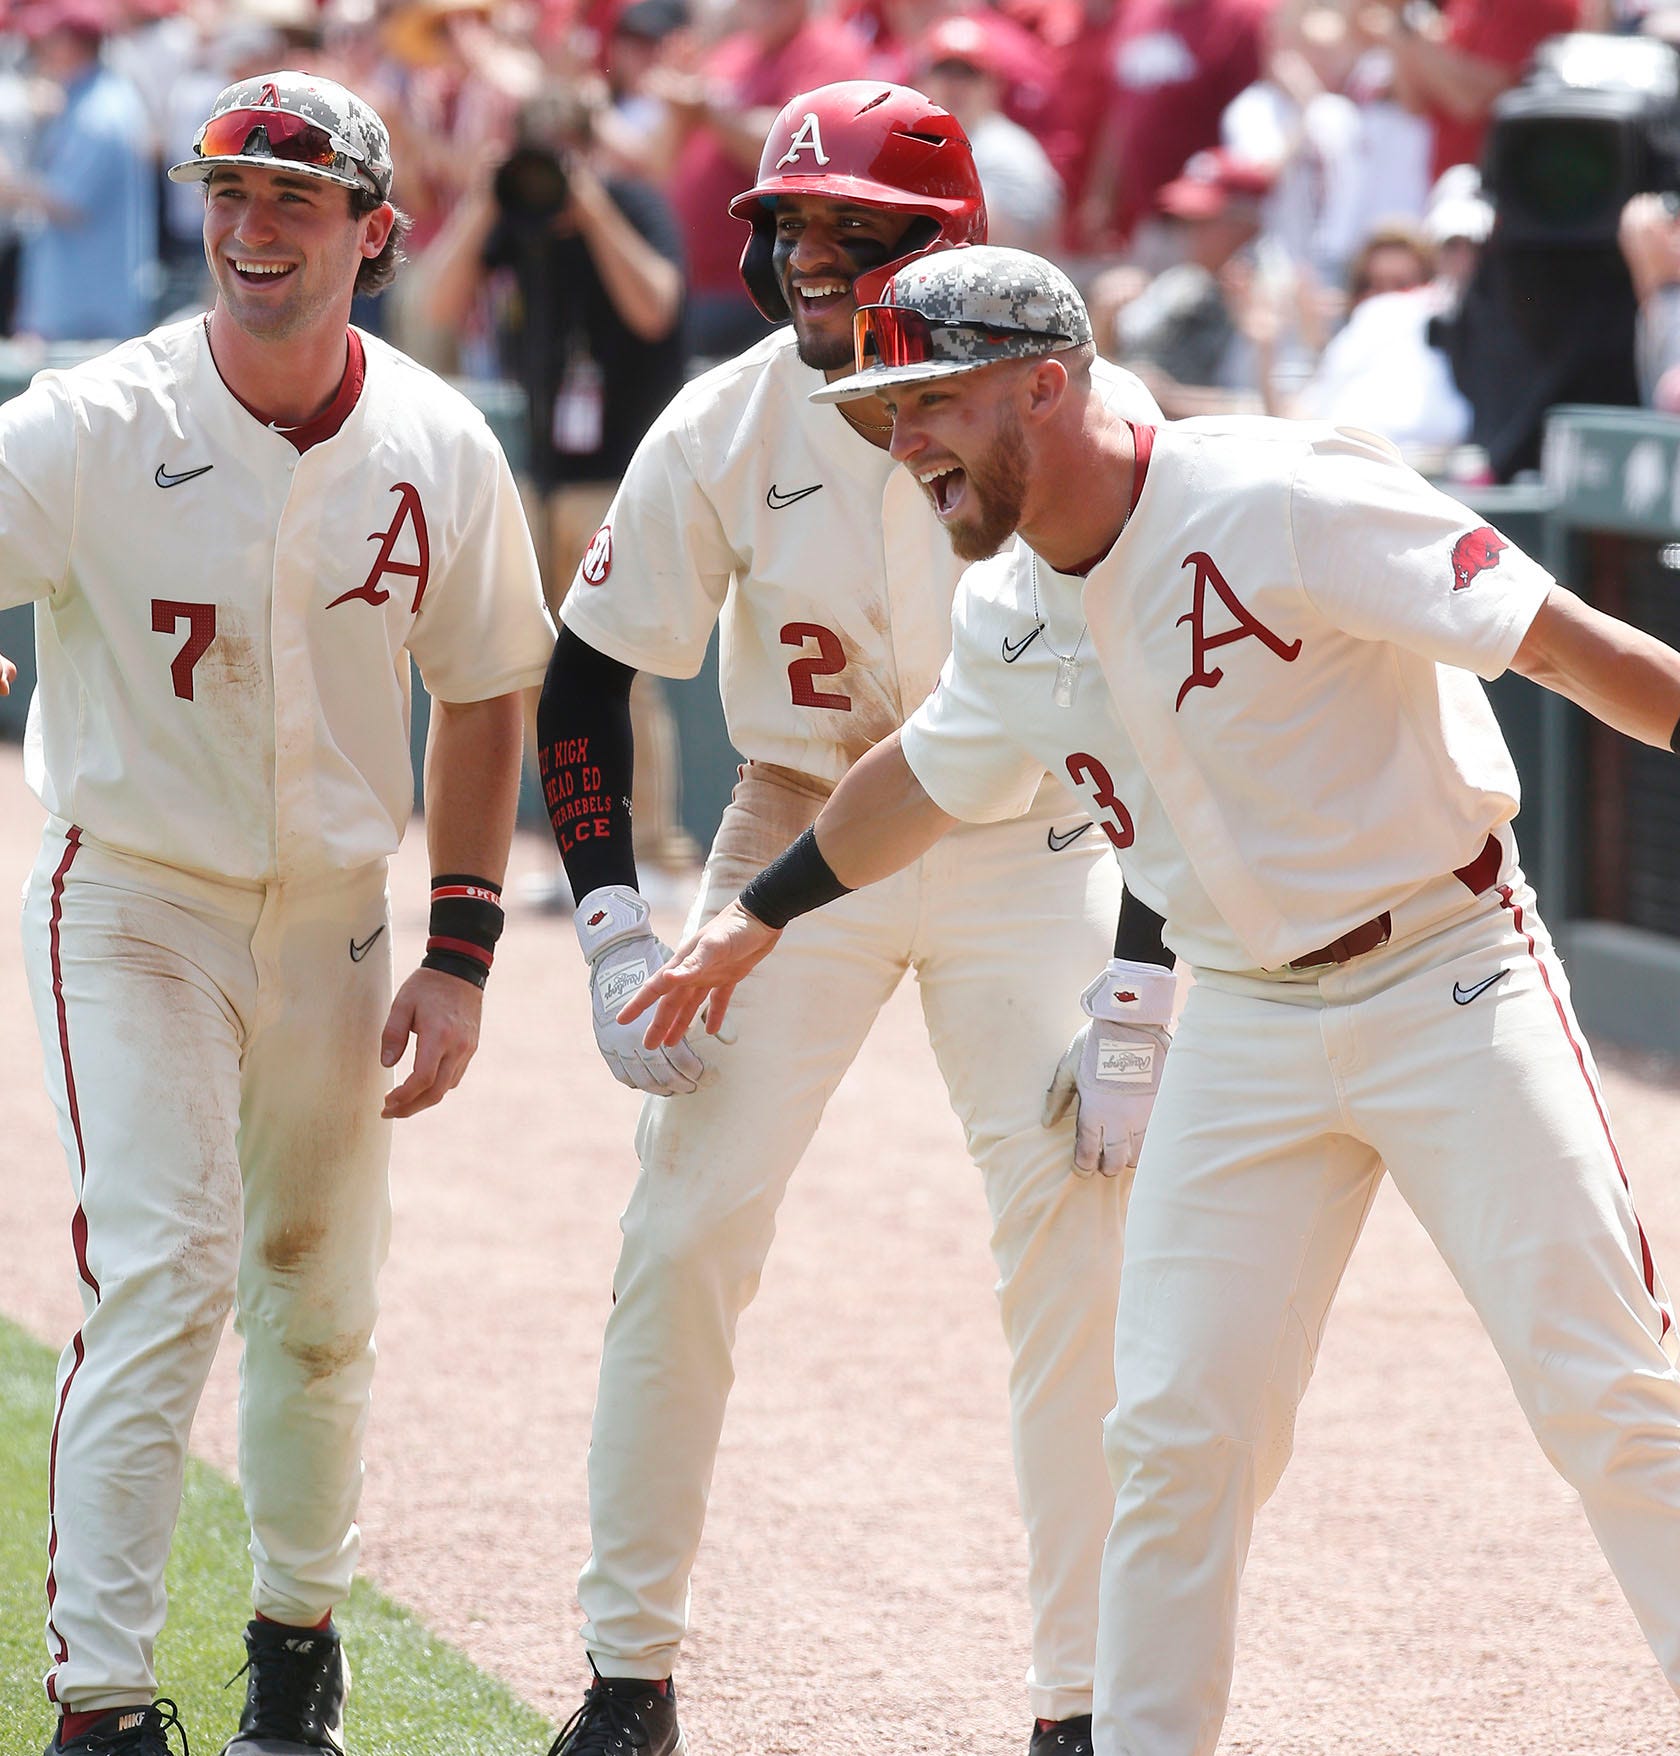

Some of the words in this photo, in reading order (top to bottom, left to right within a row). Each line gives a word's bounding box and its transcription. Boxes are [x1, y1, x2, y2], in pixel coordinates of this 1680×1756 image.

[776, 112, 830, 170] A
[325, 481, 430, 614] A
[151, 598, 216, 702] 7
[780, 622, 852, 712] 2
[1176, 551, 1303, 713] A
[546, 770, 574, 808] HEAD
[582, 766, 601, 791] ED
[555, 737, 589, 768] HIGH
[1065, 752, 1135, 849] 3
[604, 970, 645, 1000] Rawlings
[1102, 1053, 1151, 1072] Rawlings
